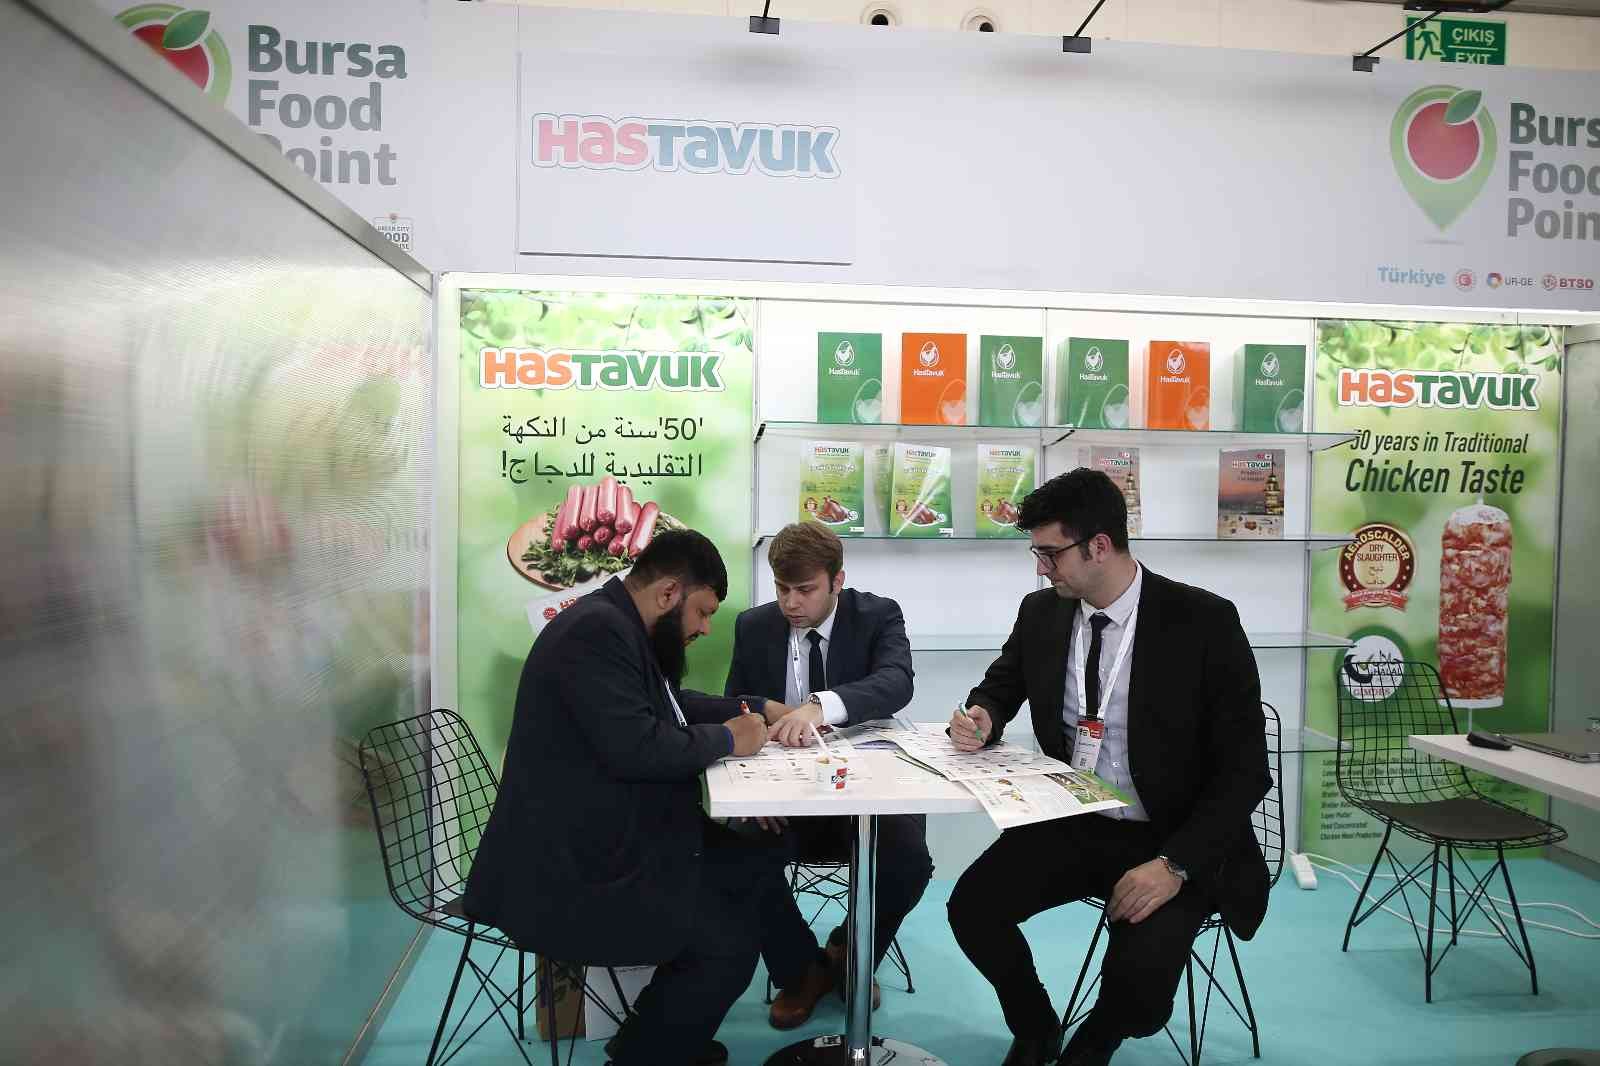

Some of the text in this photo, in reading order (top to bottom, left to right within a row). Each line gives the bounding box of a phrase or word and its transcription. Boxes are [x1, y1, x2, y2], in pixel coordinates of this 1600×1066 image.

[1452, 28, 1495, 46] ÇIKIŞ
[248, 24, 408, 80] Bursa
[1456, 52, 1491, 64] EXIT
[248, 79, 382, 132] Food
[255, 133, 397, 186] oint
[384, 233, 410, 243] OOD
[1377, 265, 1446, 287] Türkiye
[502, 415, 566, 443] النكهة
[575, 425, 606, 444] من
[1373, 434, 1418, 455] years
[1423, 432, 1439, 451] in
[1444, 432, 1529, 454] Traditional
[605, 451, 703, 485] التقليدية
[1345, 458, 1525, 495] Chicken Taste
[1357, 553, 1398, 561] SLAUGHTER
[1369, 544, 1385, 552] DRY
